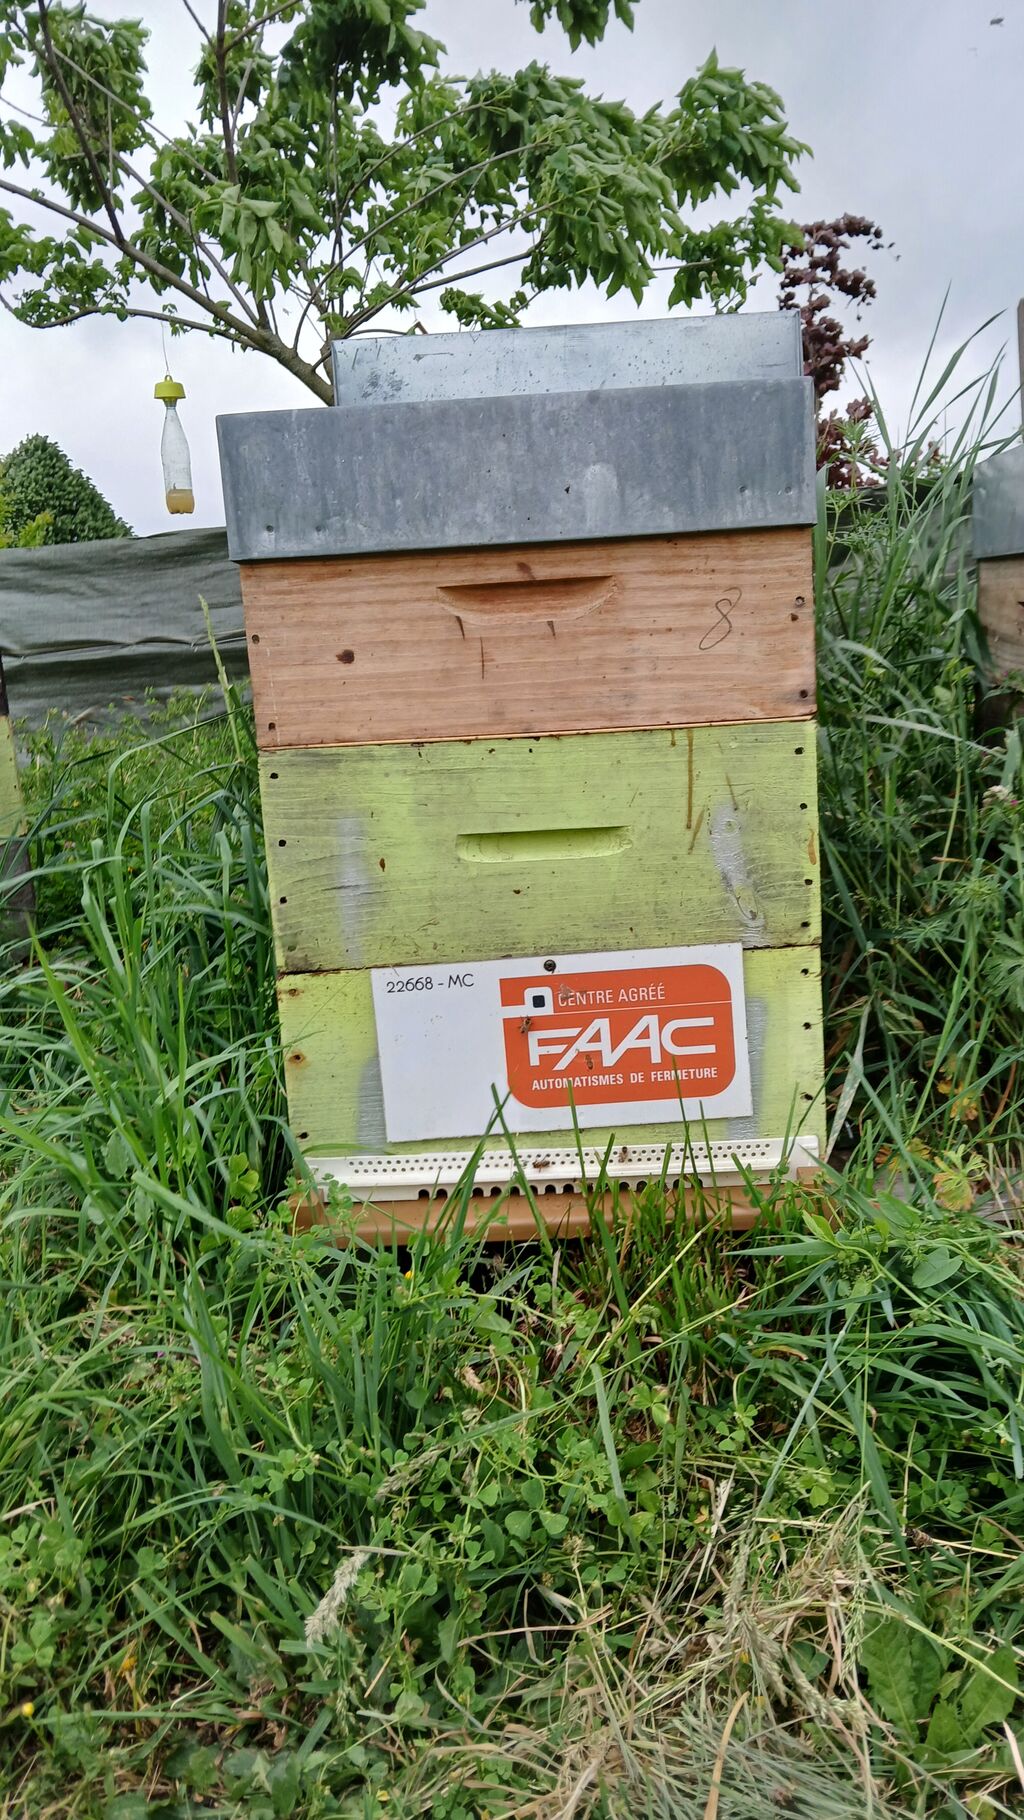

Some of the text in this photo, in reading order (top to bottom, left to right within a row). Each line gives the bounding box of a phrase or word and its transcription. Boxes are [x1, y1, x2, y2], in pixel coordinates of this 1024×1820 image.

[699, 586, 742, 651] 8
[386, 976, 434, 994] 22668
[448, 973, 475, 989] MC
[558, 983, 666, 1007] CENTRE AGRÉÉ
[527, 1014, 717, 1072] FAAC
[630, 1072, 645, 1083] DE
[651, 1067, 718, 1083] FERMETURE
